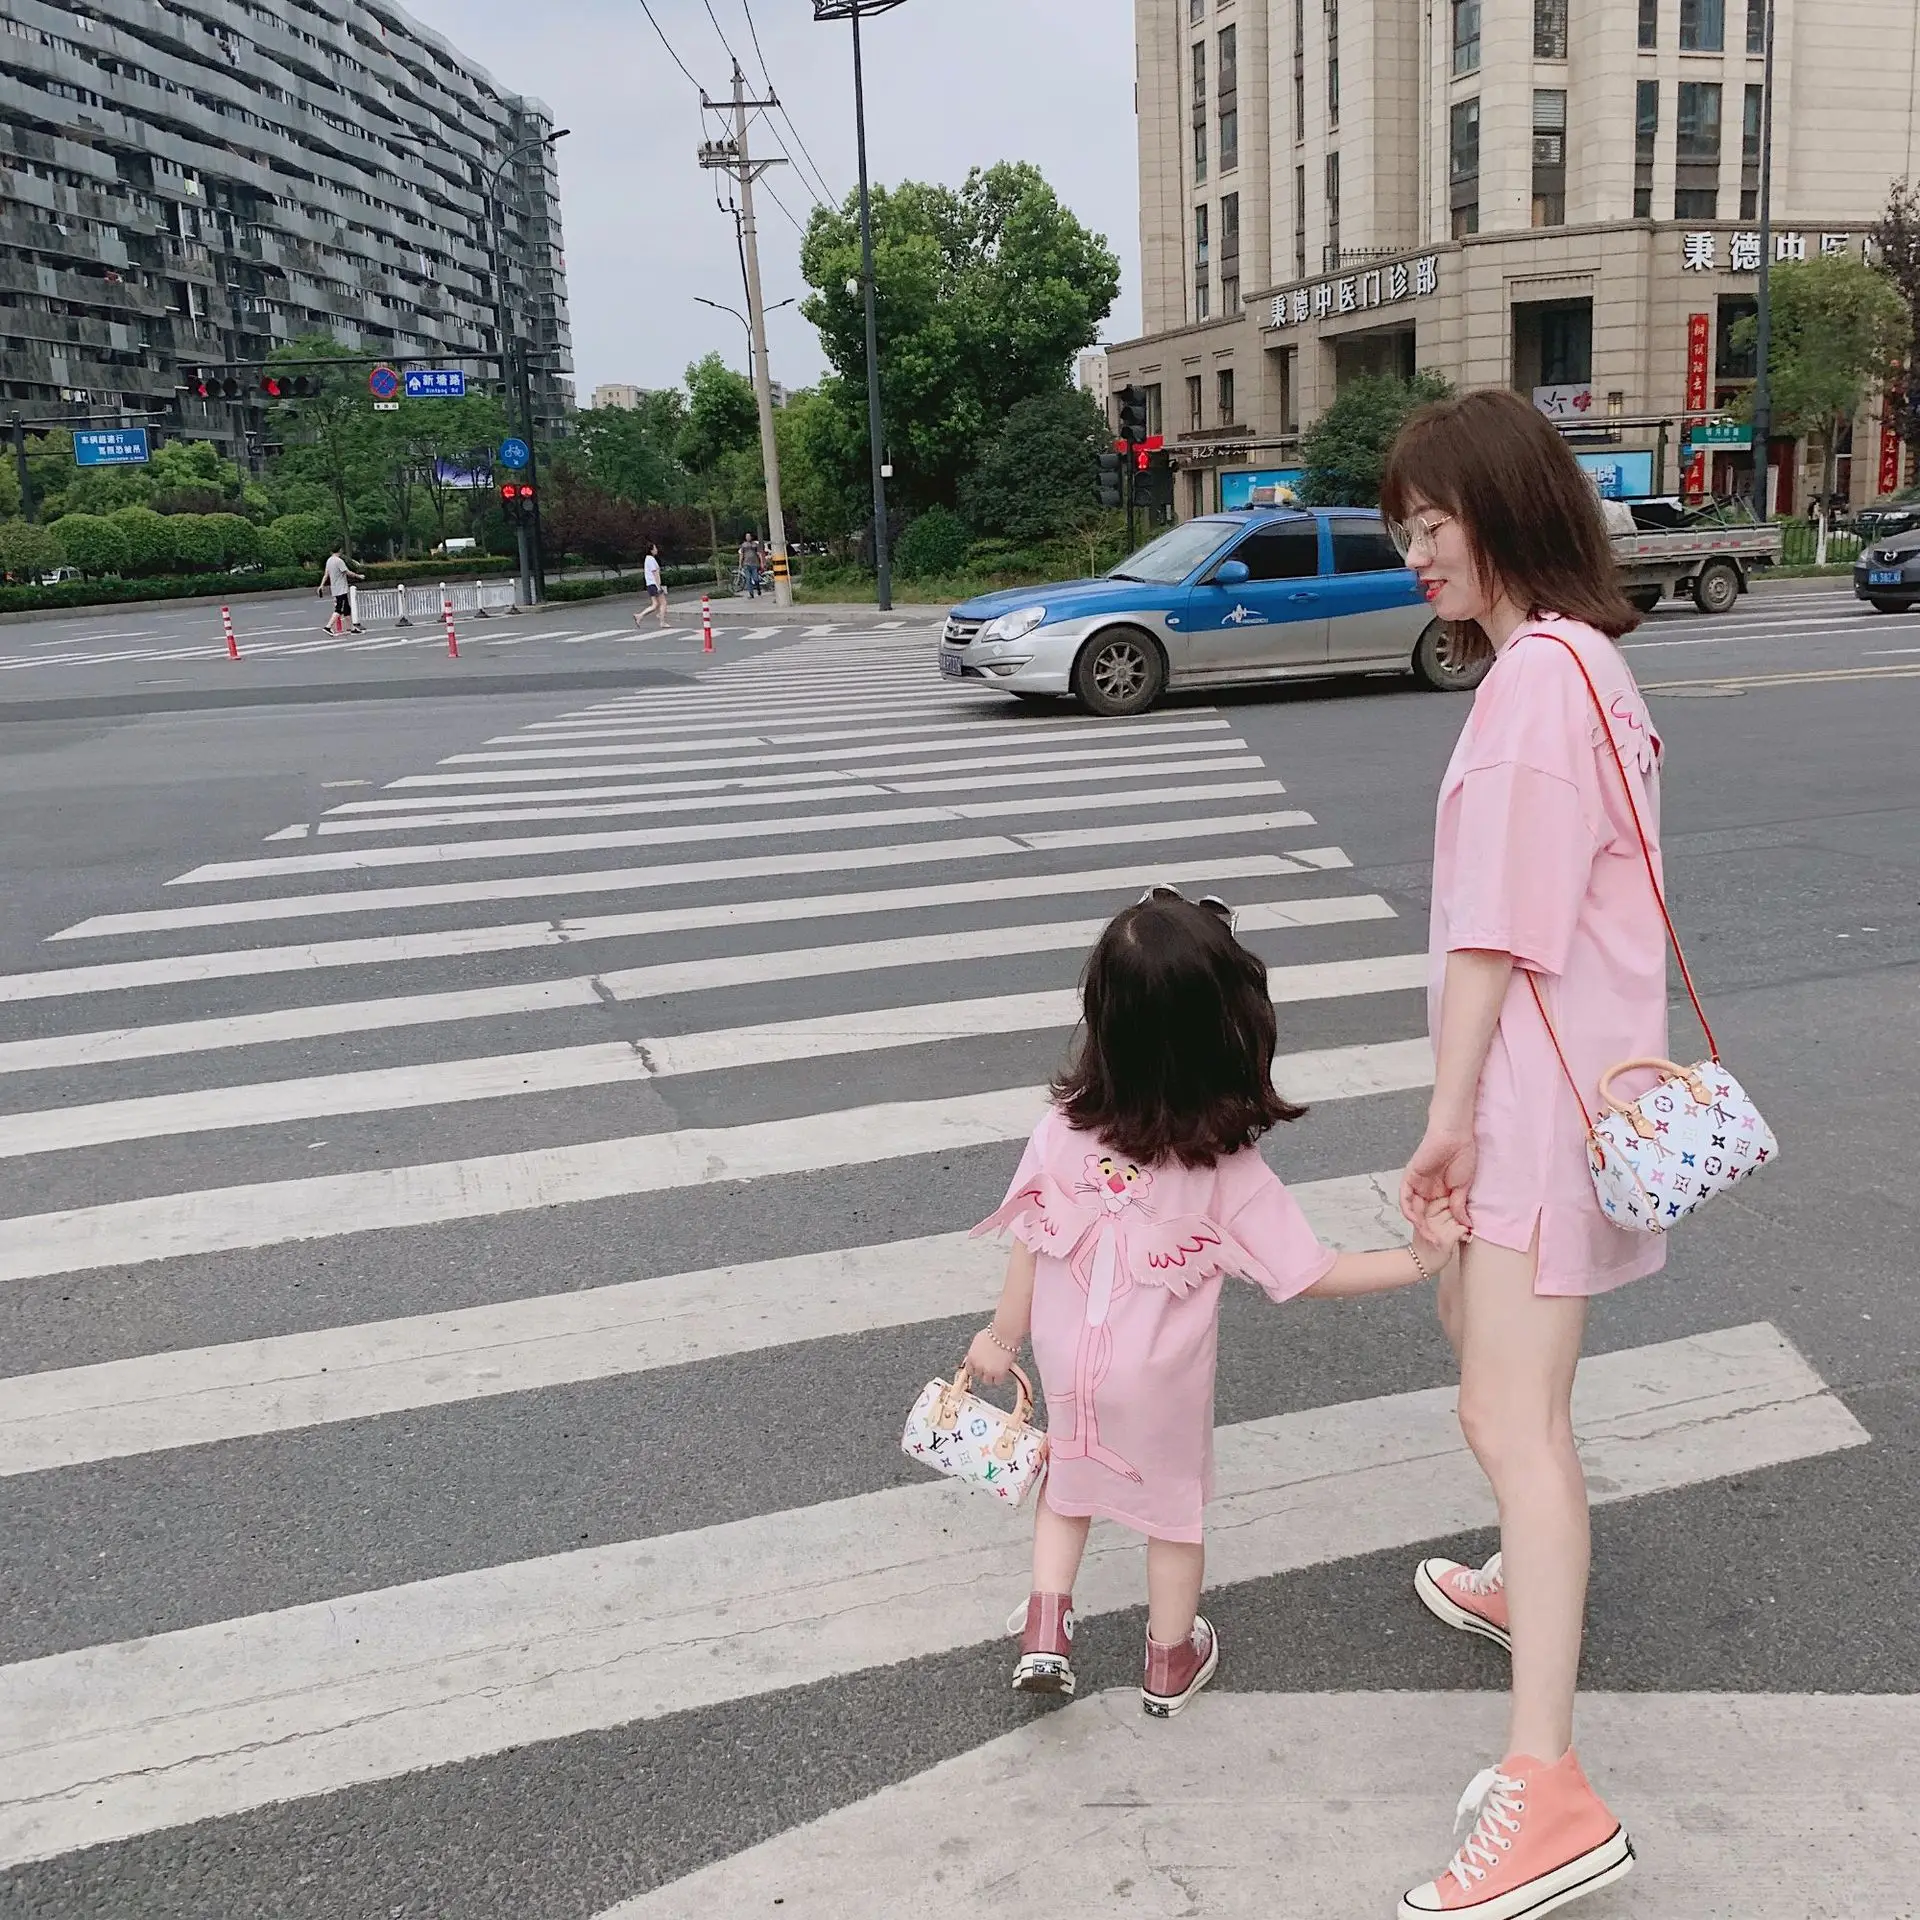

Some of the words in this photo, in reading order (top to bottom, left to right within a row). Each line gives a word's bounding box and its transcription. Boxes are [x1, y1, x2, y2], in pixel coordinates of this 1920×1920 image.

[1271, 256, 1438, 327] 秉德中医门诊部
[422, 374, 461, 386] 新塘路
